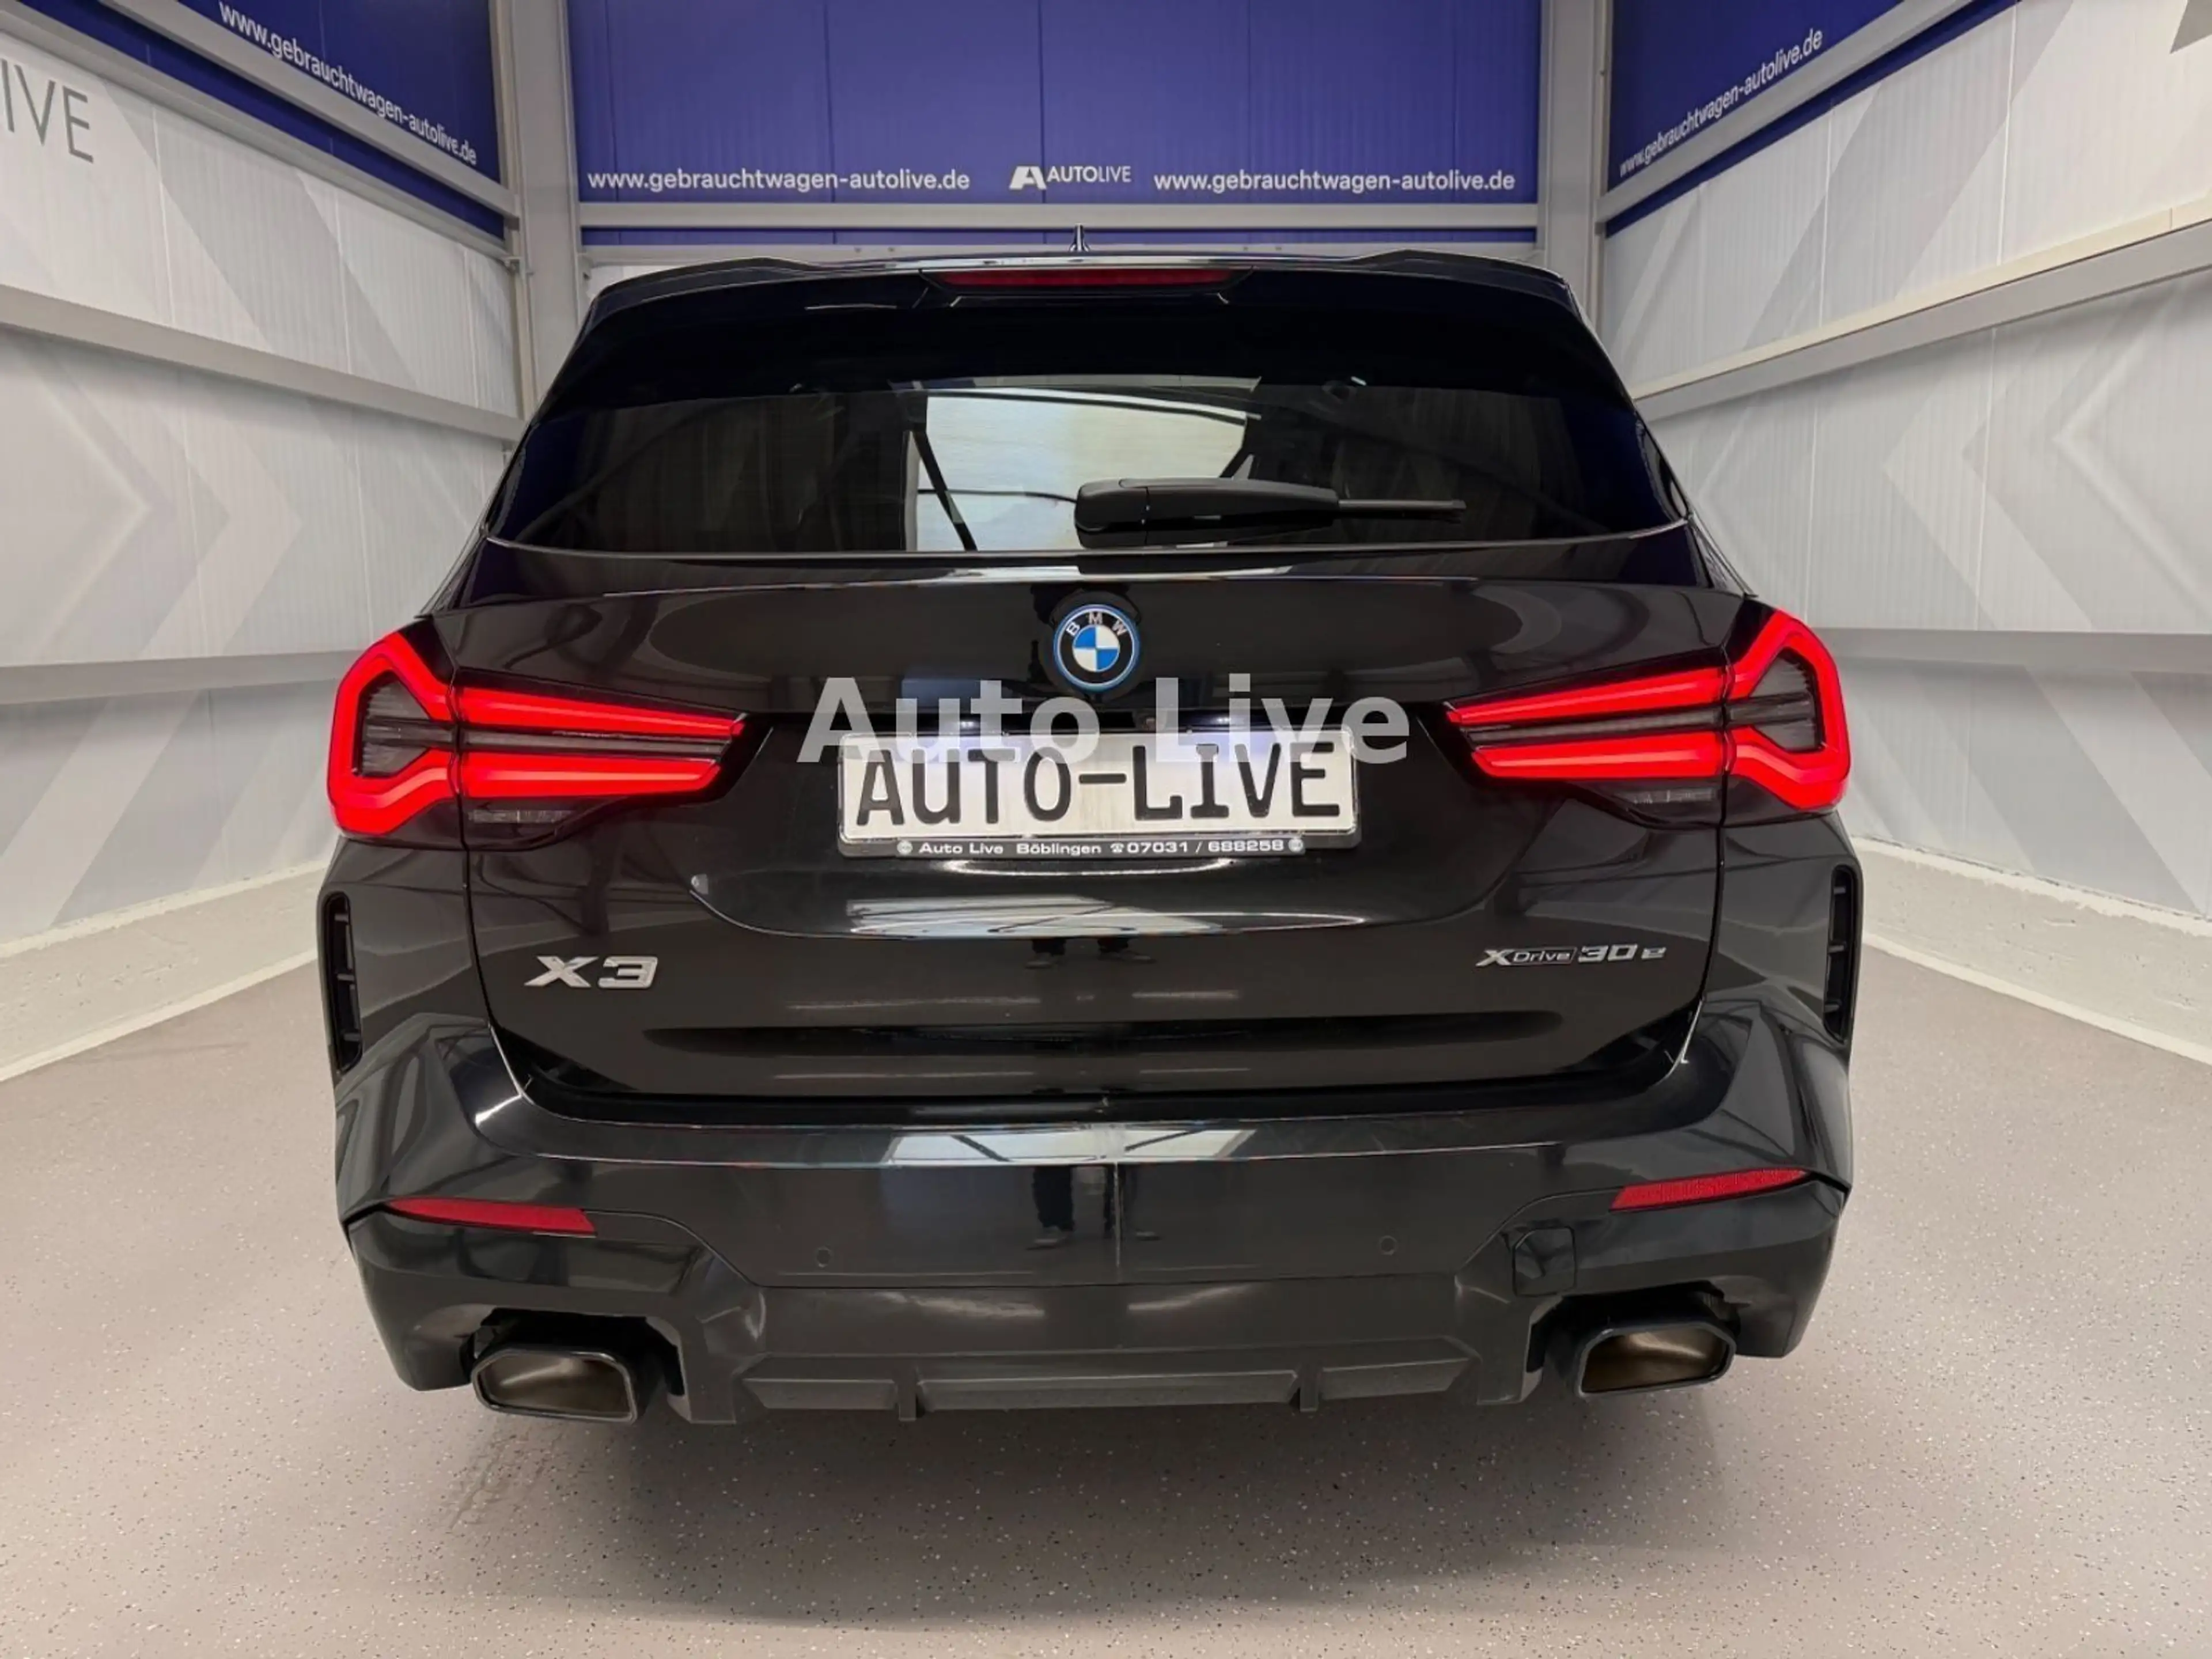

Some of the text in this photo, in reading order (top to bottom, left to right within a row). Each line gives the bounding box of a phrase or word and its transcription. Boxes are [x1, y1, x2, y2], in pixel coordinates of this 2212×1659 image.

[219, 1, 478, 166] www.gebrauchtwagen-autolive.de
[1619, 28, 1823, 178] www.gebrauchtwagen-autolive.de
[587, 168, 971, 193] www.gebrauchtwagen-autolive.de
[1046, 165, 1132, 183] AUTOLIVE
[1153, 169, 1516, 194] www.gebrauchtwagen-autolive.de
[1066, 611, 1127, 637] BMW
[856, 741, 1341, 827] AUTO-LIVE
[918, 842, 963, 854] Auto
[968, 842, 1004, 854] Live
[1016, 842, 1102, 856] Böblingen
[523, 955, 658, 988] X3
